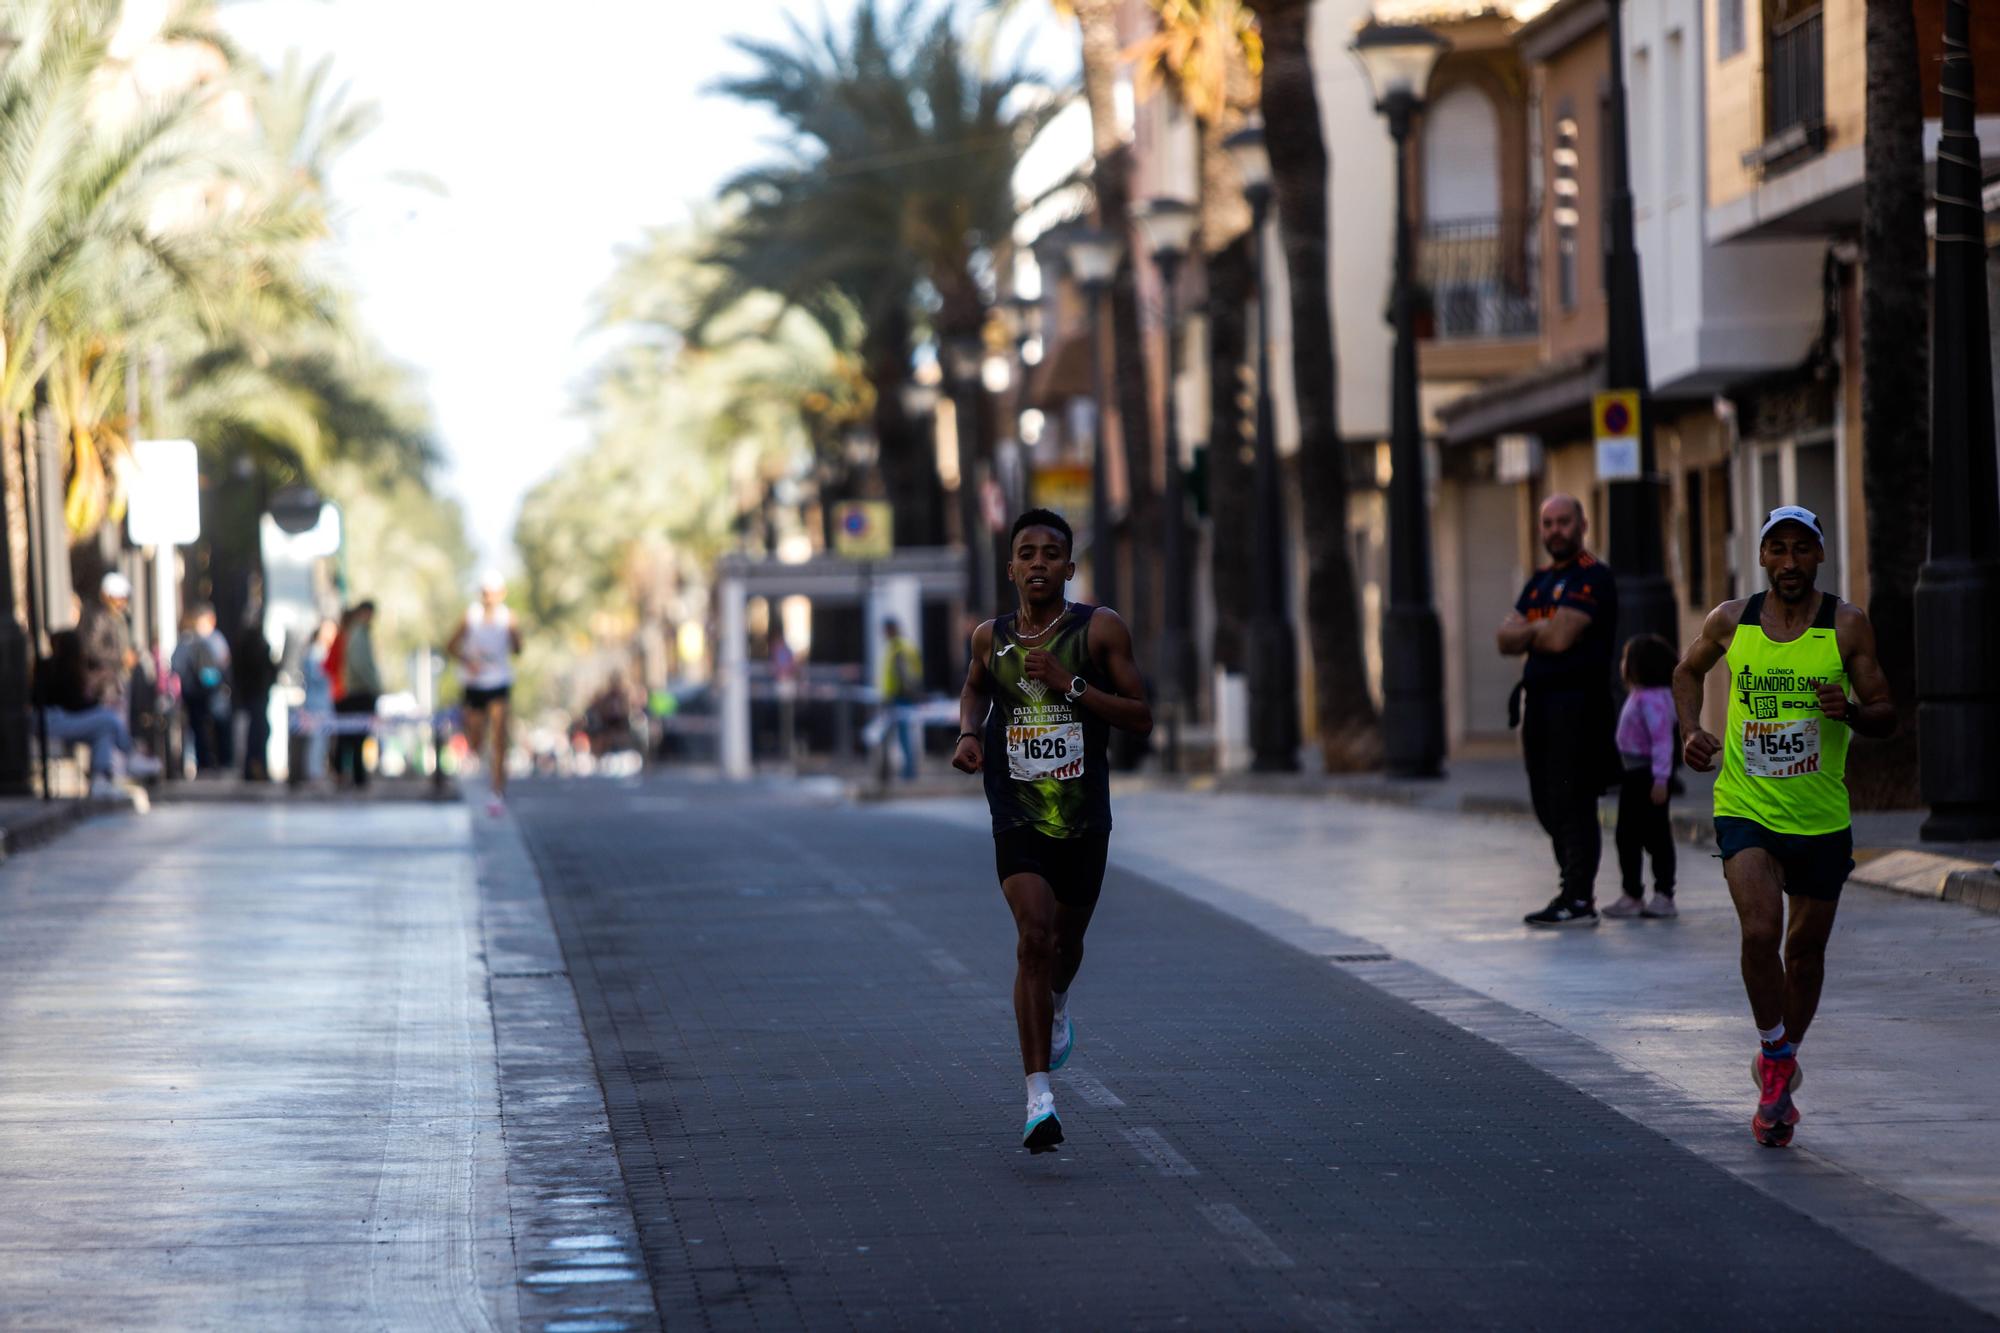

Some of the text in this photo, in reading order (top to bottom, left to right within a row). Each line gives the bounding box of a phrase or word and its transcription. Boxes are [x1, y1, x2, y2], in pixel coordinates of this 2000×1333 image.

[1767, 667, 1794, 675] CLÍNICA
[1737, 676, 1795, 691] ALEJANDRO
[1013, 704, 1073, 715] CAIXA RURAL
[1757, 709, 1776, 718] BUY
[1022, 738, 1067, 759] 1626
[1759, 733, 1804, 754] 1545
